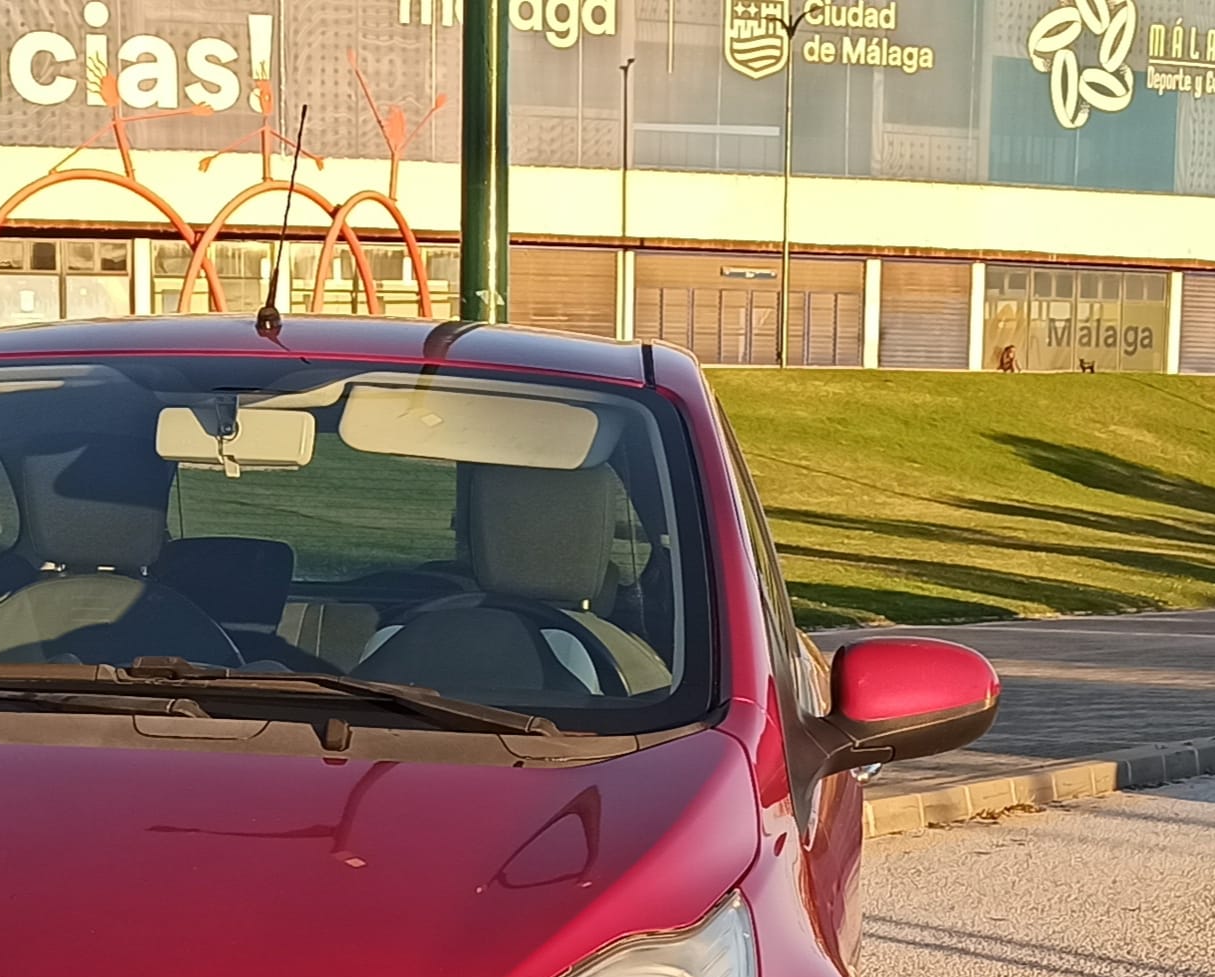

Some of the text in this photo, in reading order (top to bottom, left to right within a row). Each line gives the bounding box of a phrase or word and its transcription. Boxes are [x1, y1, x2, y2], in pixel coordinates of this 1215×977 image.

[804, 0, 896, 29] Ciudad
[803, 35, 933, 74] de Málaga
[1147, 65, 1192, 96] Deporte
[1194, 75, 1203, 98] y
[1046, 316, 1153, 356] Málaga
